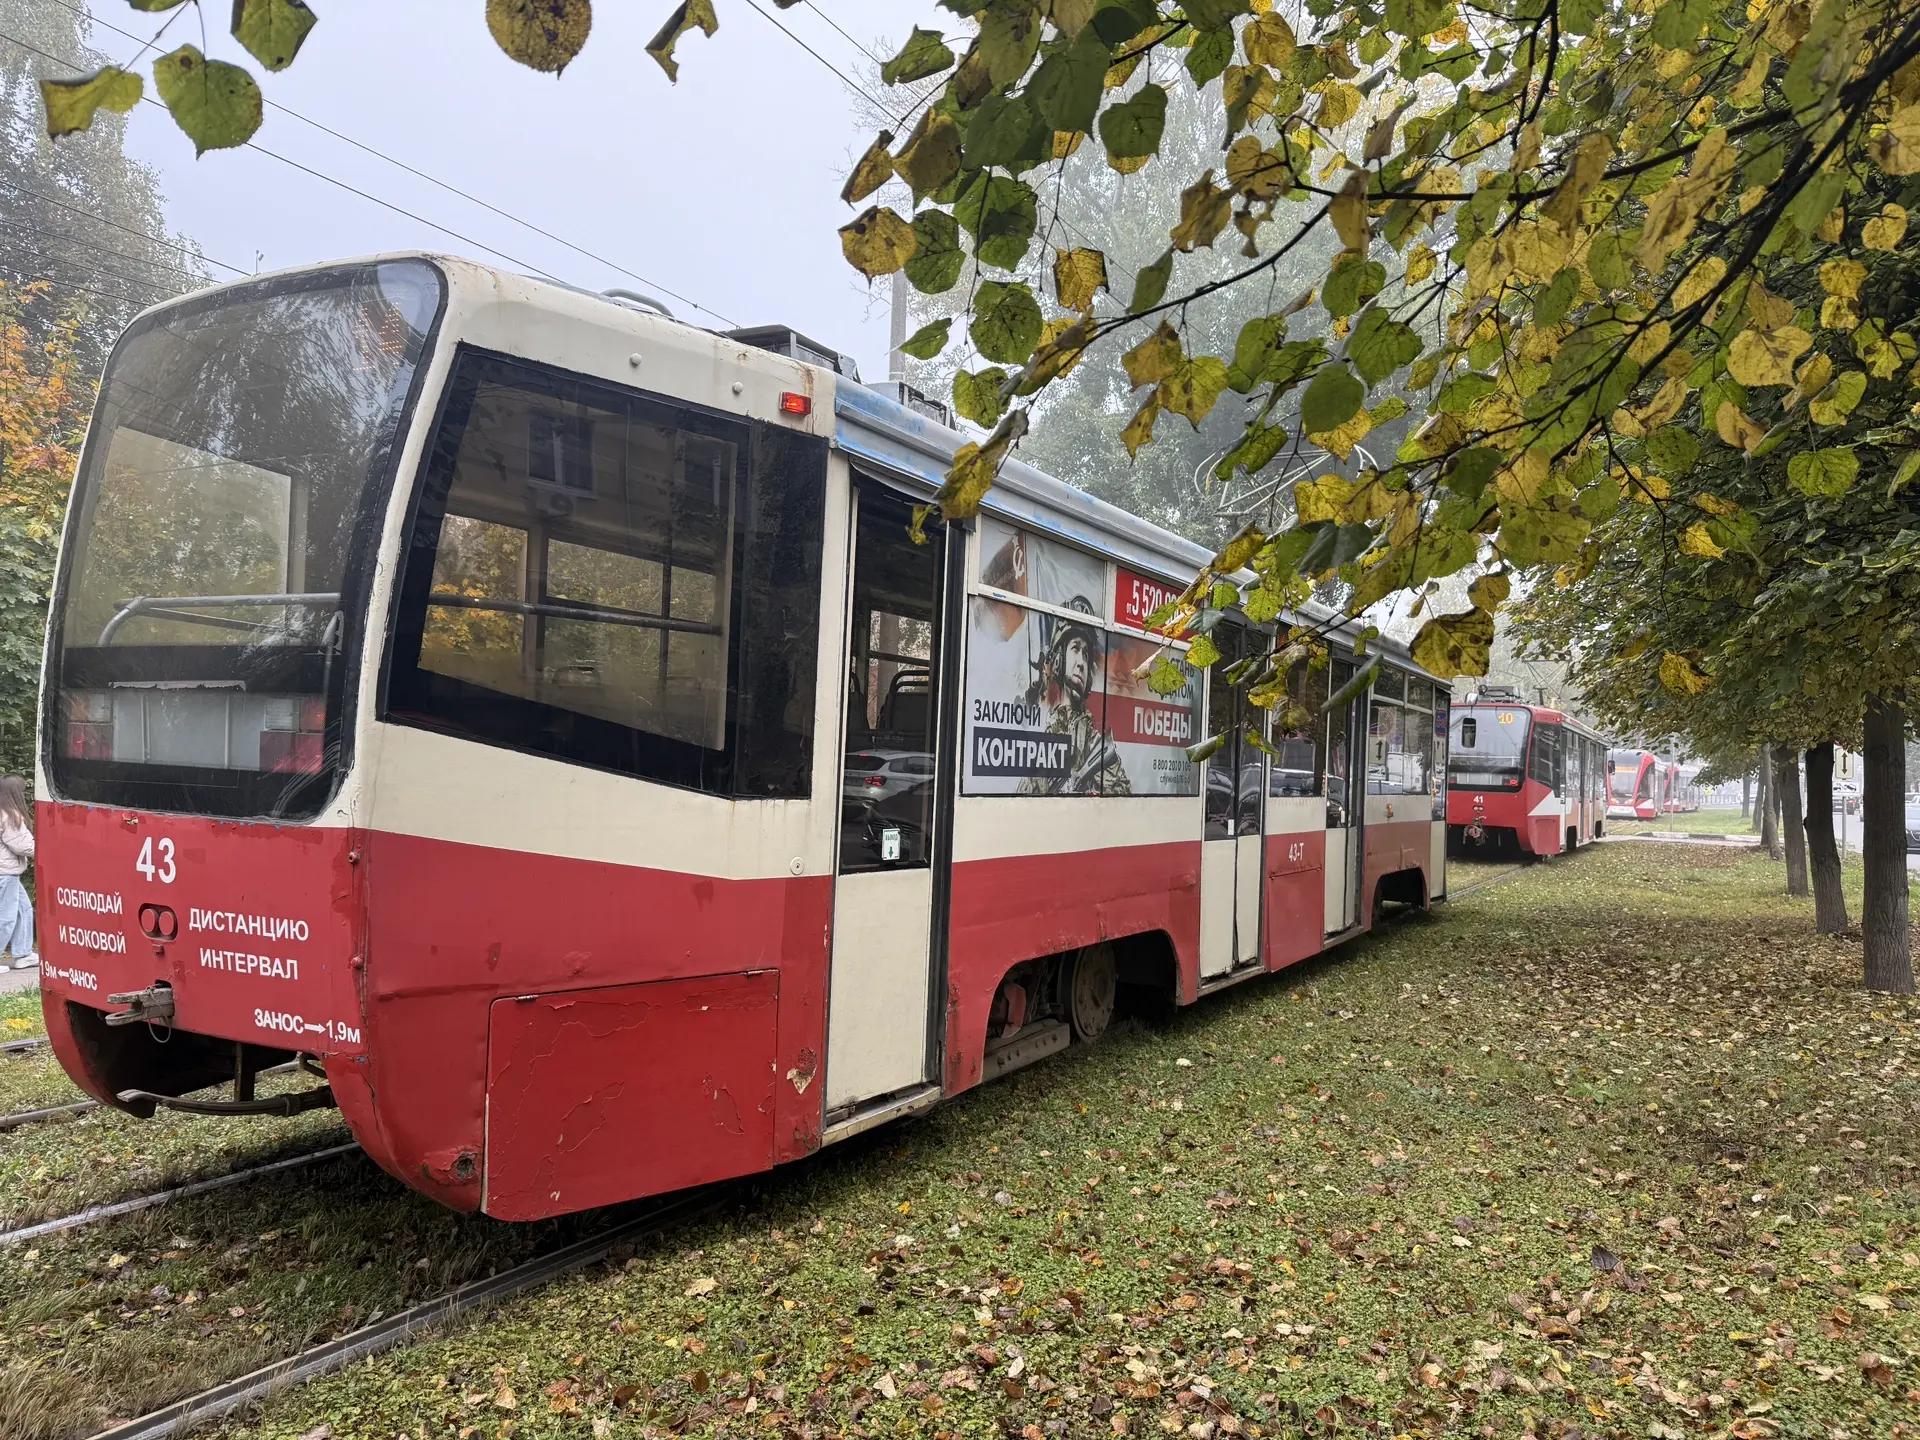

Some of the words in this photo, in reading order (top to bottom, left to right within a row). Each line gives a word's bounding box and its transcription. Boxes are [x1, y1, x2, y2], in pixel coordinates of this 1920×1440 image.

[1132, 579, 1140, 616] 5
[973, 698, 1041, 727] ЗАКЛЮЧИ
[1133, 706, 1192, 743] ПОБЕДЫ
[977, 737, 1068, 769] КОНТРАКТ
[1473, 795, 1484, 804] 41
[136, 836, 177, 884] 43
[57, 887, 123, 915] СОБЛЮДАЙ
[188, 907, 309, 942] ДИСТАНЦИЮ
[59, 924, 68, 943] И
[69, 926, 126, 954] БОКОВОЙ
[200, 947, 299, 980] ИНТЕРВАЛ
[68, 967, 98, 991] ЗАНОС
[254, 1008, 304, 1034] ЗАНОС
